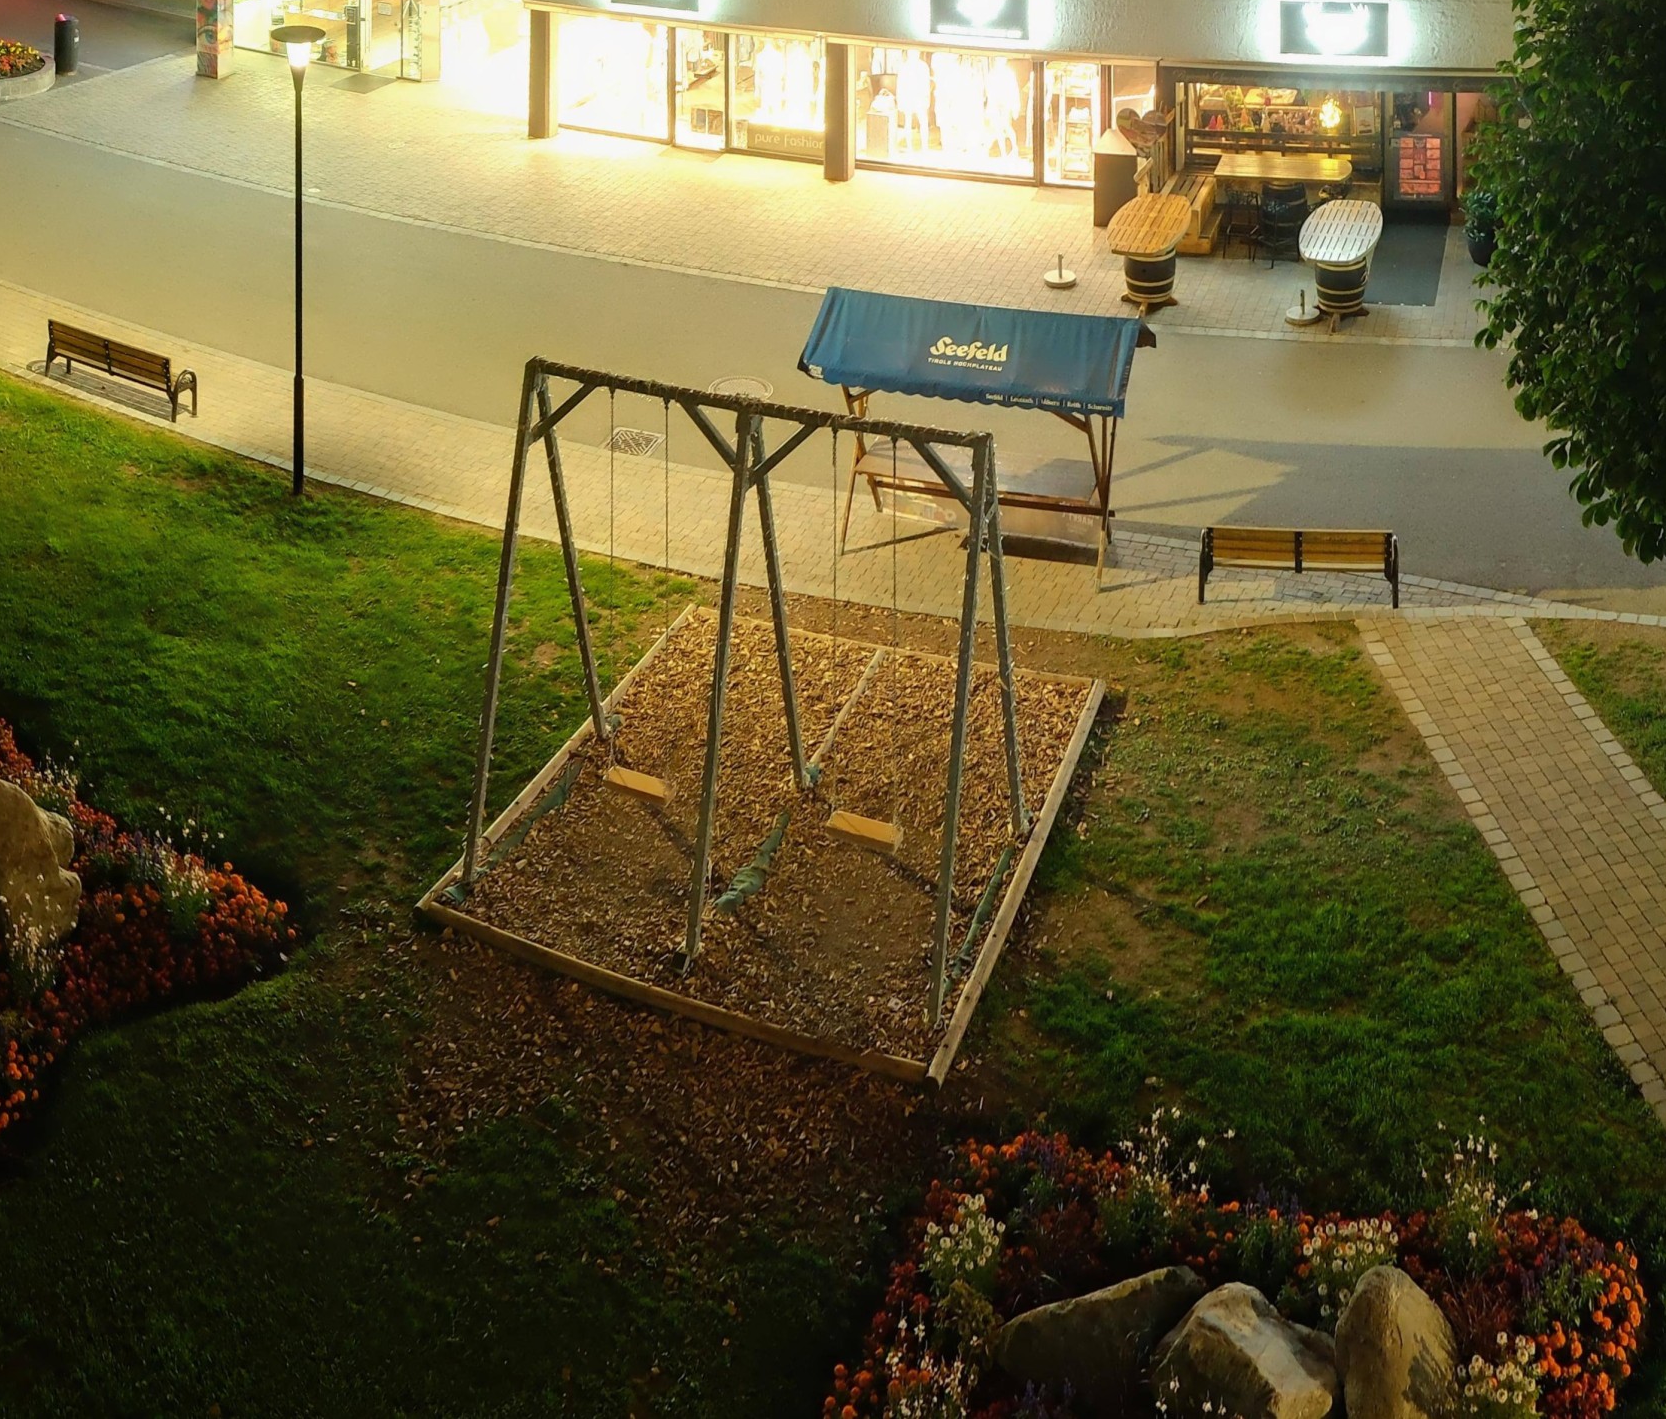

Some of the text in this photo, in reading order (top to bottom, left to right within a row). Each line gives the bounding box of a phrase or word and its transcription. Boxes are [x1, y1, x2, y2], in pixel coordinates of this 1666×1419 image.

[754, 133, 781, 144] pure
[930, 336, 1010, 362] Seefeld
[928, 357, 1004, 372] TIROLS HOCHPLATEAU
